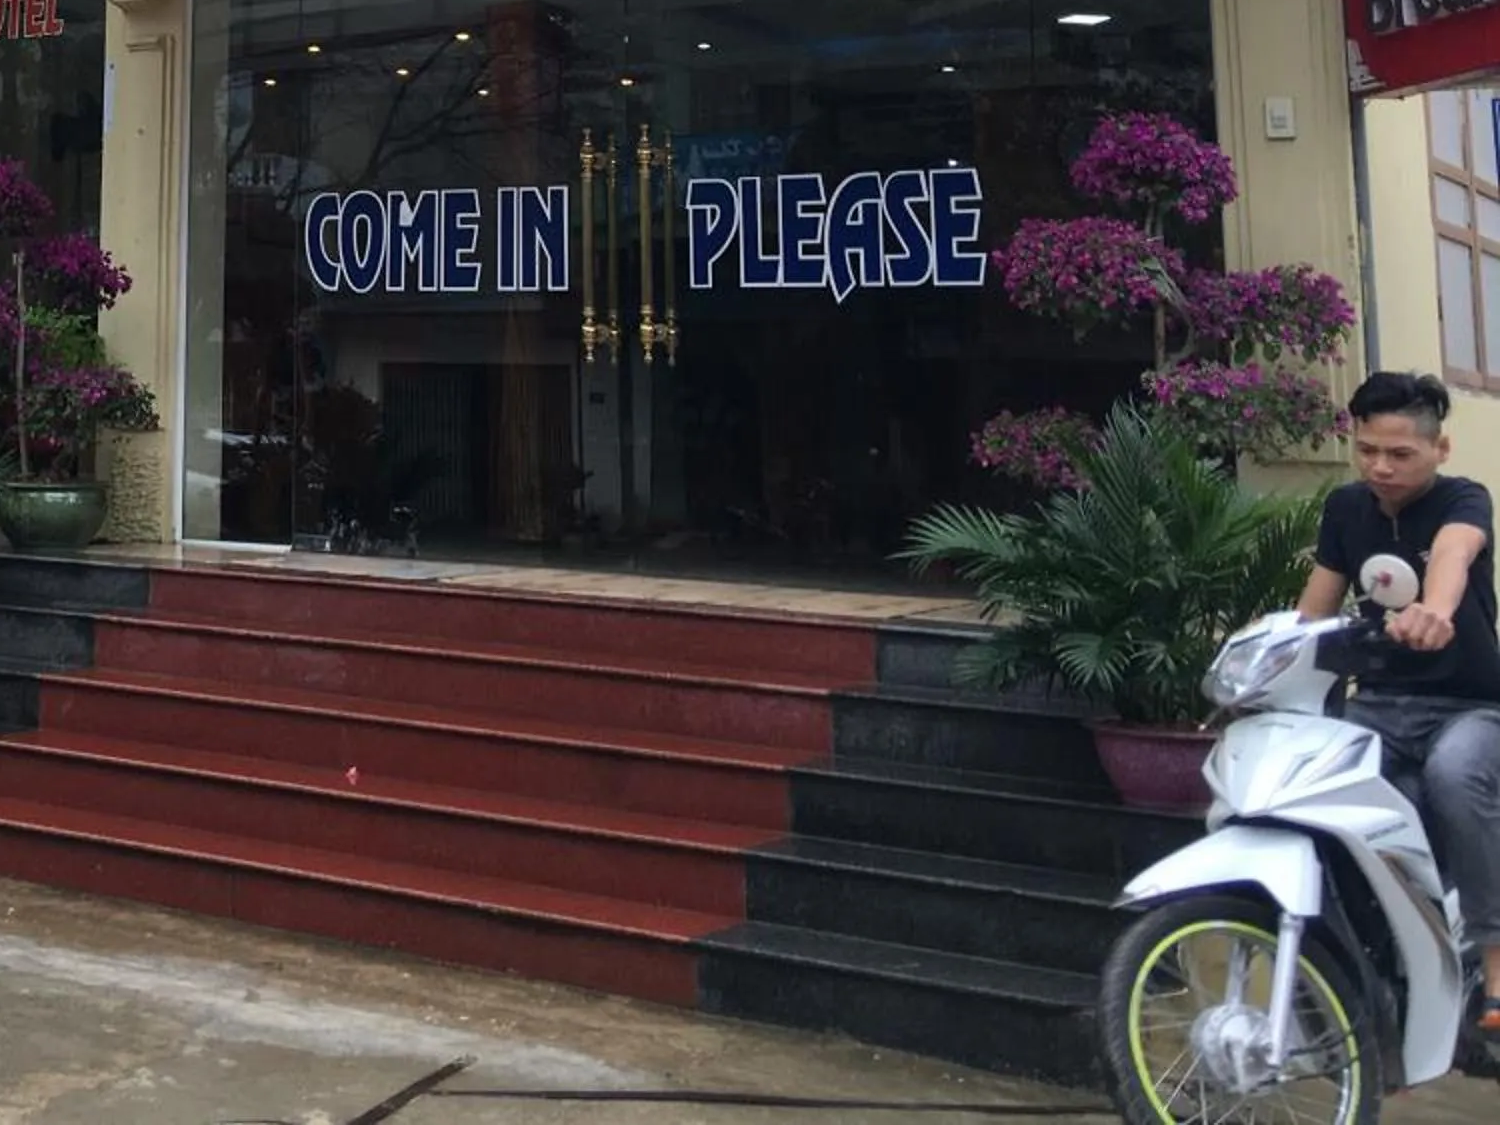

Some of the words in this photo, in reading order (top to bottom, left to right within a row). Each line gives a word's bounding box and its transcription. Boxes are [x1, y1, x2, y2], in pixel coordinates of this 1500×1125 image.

[304, 187, 482, 294] COME
[496, 185, 570, 293] IN
[684, 167, 988, 304] PLEASE
